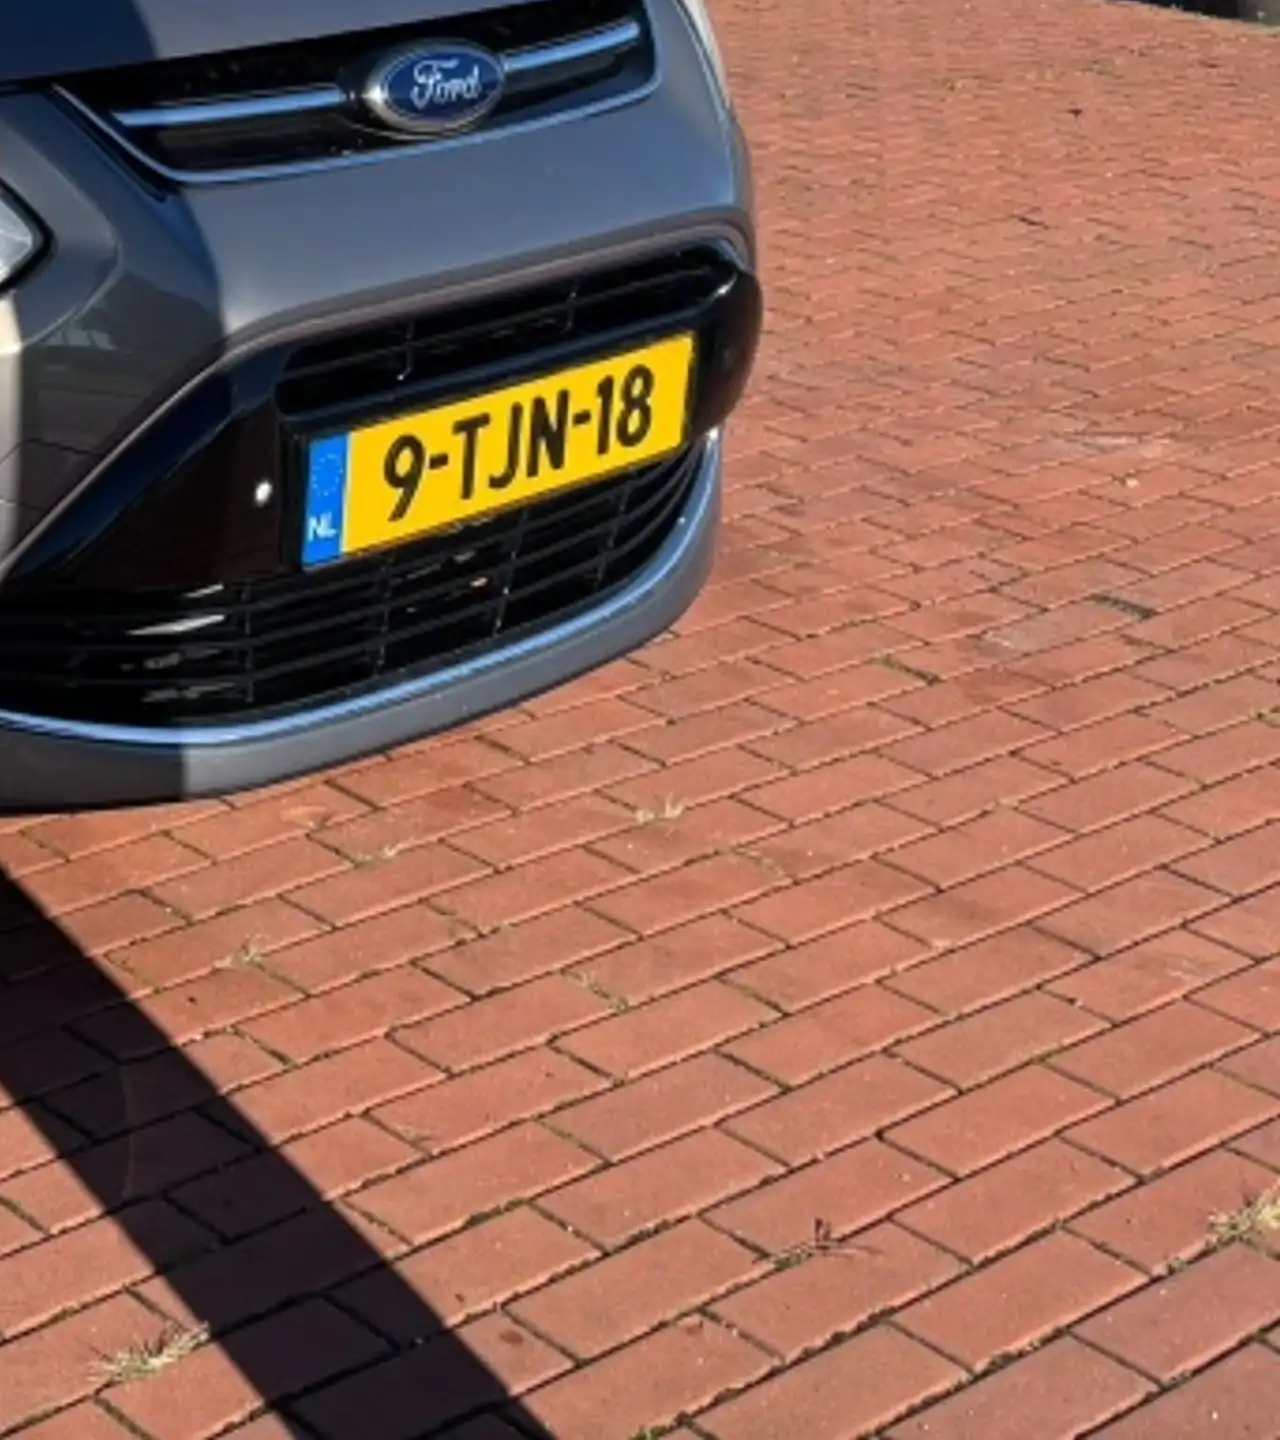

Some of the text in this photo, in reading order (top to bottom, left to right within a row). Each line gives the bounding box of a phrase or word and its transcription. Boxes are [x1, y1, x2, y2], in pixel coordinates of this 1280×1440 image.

[410, 58, 482, 110] Ford
[383, 364, 655, 522] 9-TJN-18
[307, 511, 336, 541] NL
